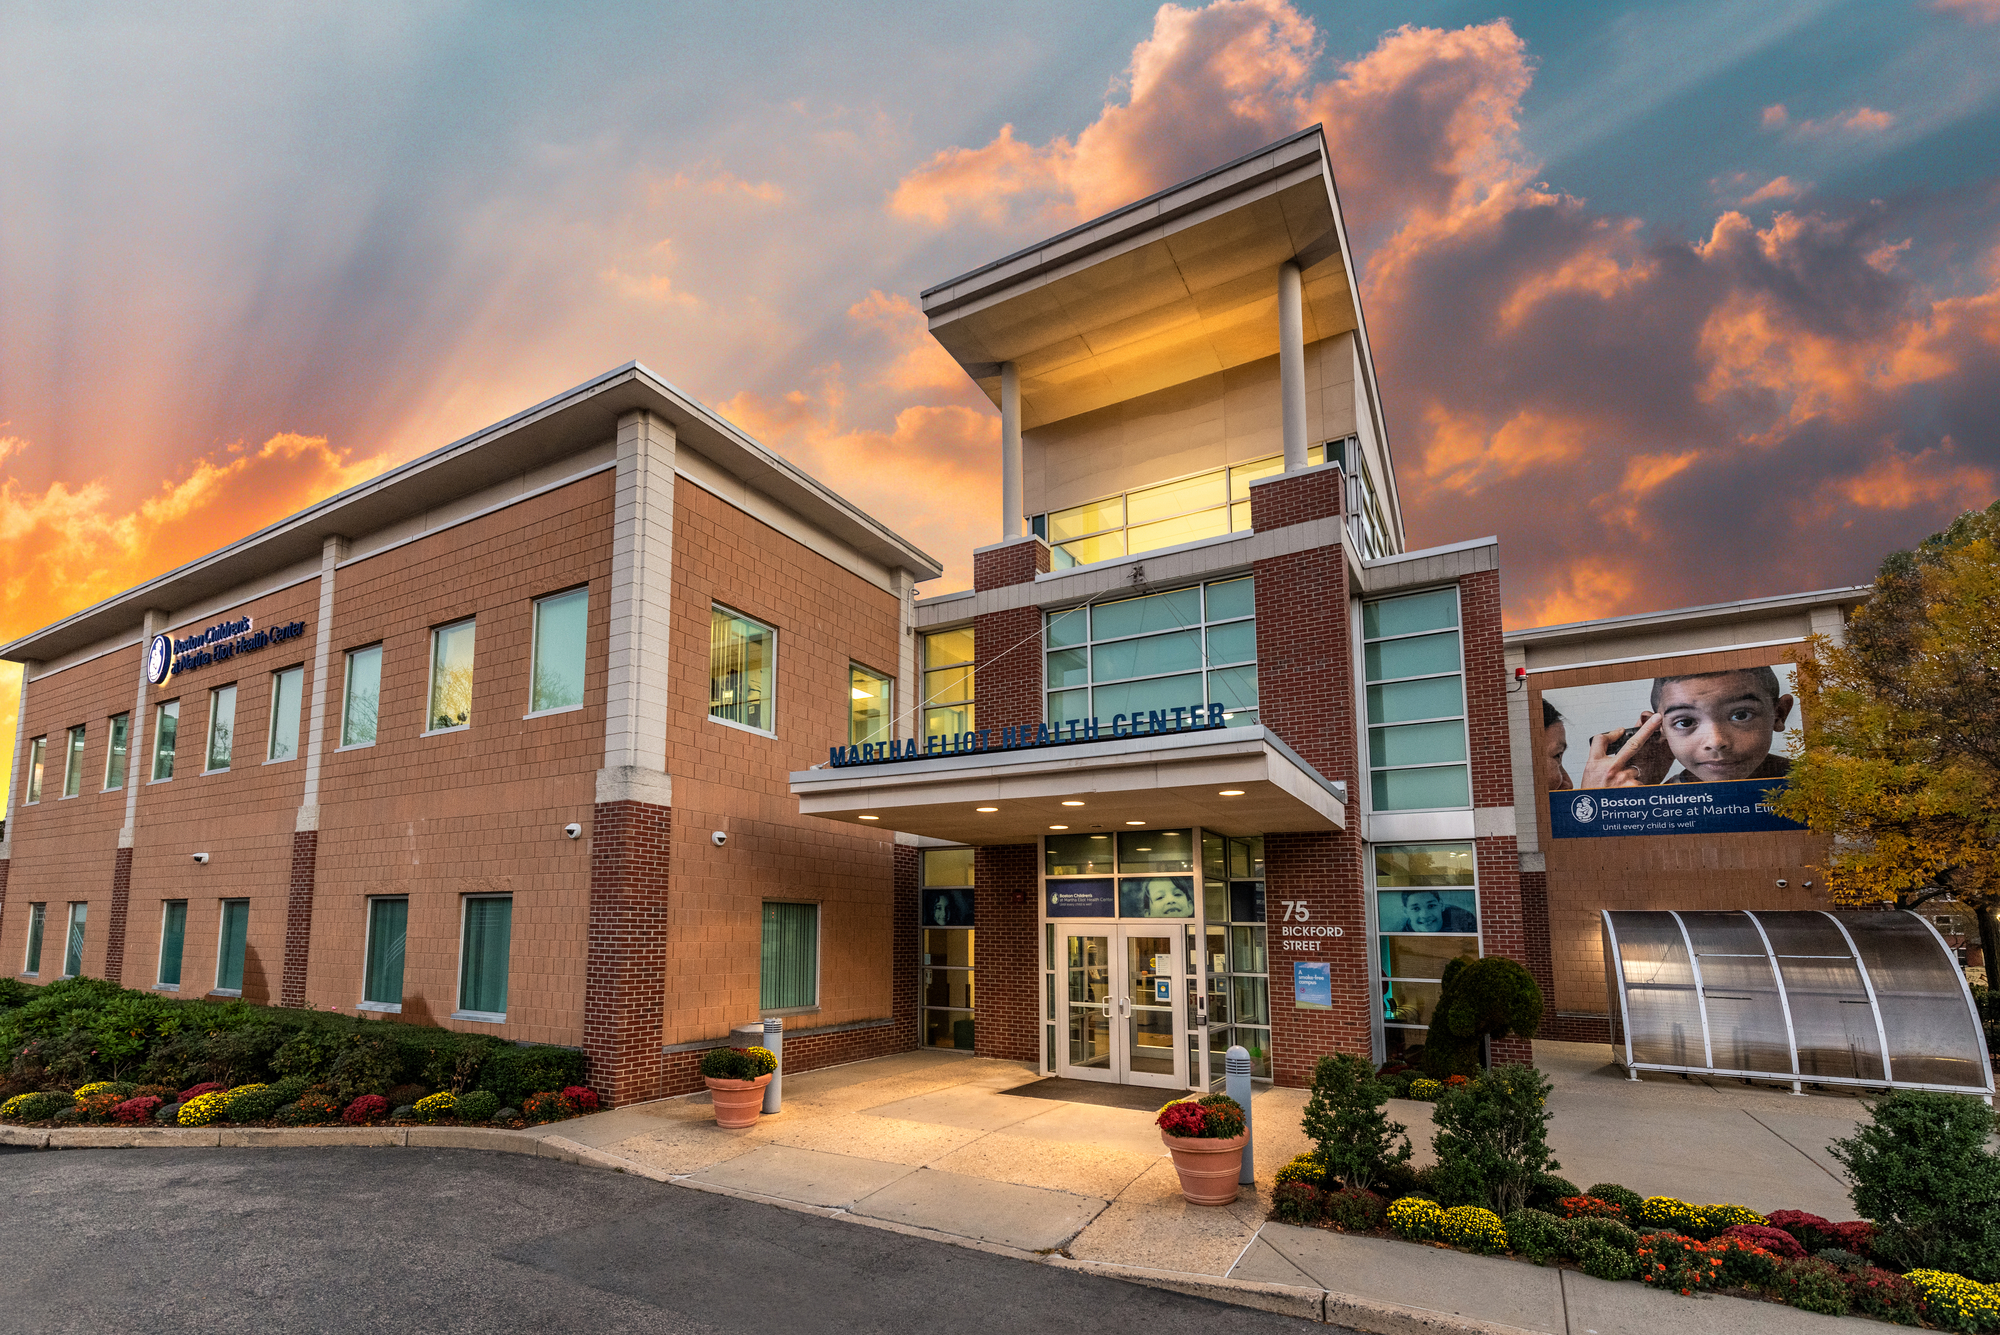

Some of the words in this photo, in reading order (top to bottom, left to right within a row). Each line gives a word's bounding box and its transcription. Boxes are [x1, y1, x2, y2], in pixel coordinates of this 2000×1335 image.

[171, 659, 180, 675] at
[180, 650, 211, 671] Martha
[213, 641, 233, 661] Eliot
[235, 630, 268, 654] Health
[268, 621, 305, 643] Center
[173, 633, 204, 655] Boston
[829, 738, 919, 767] MARTHA
[927, 729, 992, 757] ELIOT
[1002, 716, 1099, 749] HEALTH
[1112, 702, 1226, 737] CENTER
[1600, 798, 1646, 808] Boston
[1649, 792, 1714, 805] Children's
[1601, 809, 1649, 820] Primary
[1652, 807, 1683, 818] Care
[1686, 806, 1699, 816] at
[1703, 804, 1750, 815] Martha
[1602, 823, 1621, 831] Until
[1623, 823, 1645, 831] every
[1646, 821, 1667, 829] child
[1281, 900, 1310, 922] 75
[1282, 926, 1344, 937] BICKFORD
[1283, 940, 1321, 951] STREET
